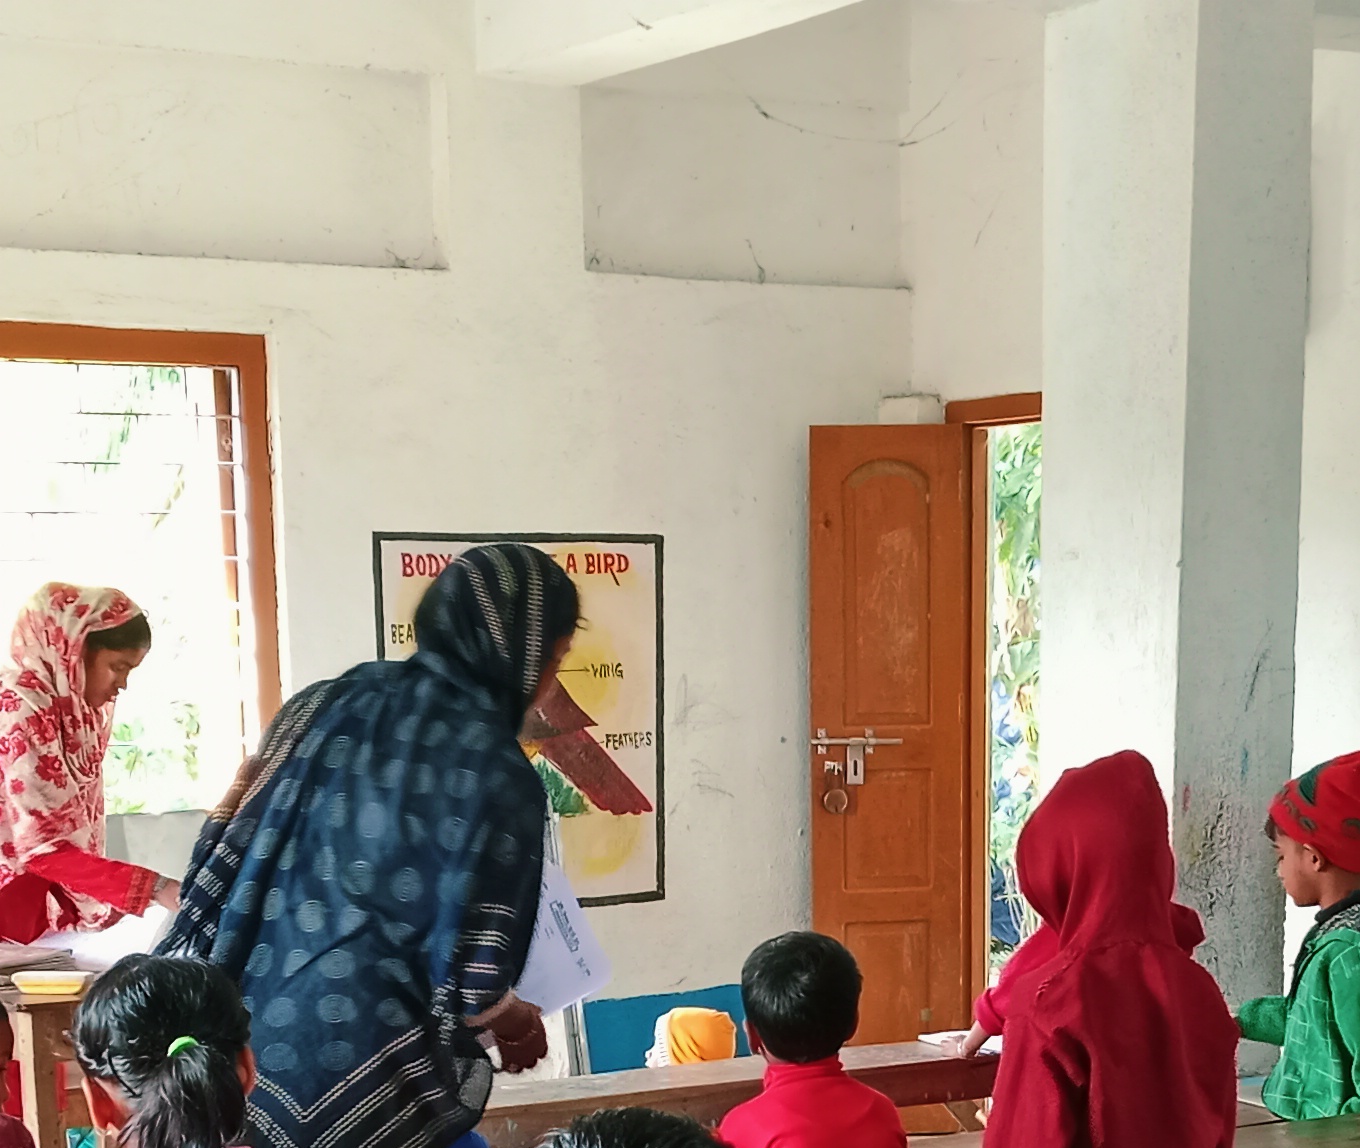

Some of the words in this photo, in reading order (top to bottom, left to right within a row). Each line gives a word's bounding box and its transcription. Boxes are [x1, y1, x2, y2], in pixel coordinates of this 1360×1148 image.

[401, 552, 452, 578] BODY
[566, 553, 577, 574] A
[585, 553, 629, 586] BIRD
[391, 623, 417, 644] BEA
[605, 731, 652, 751] FEATHERS
